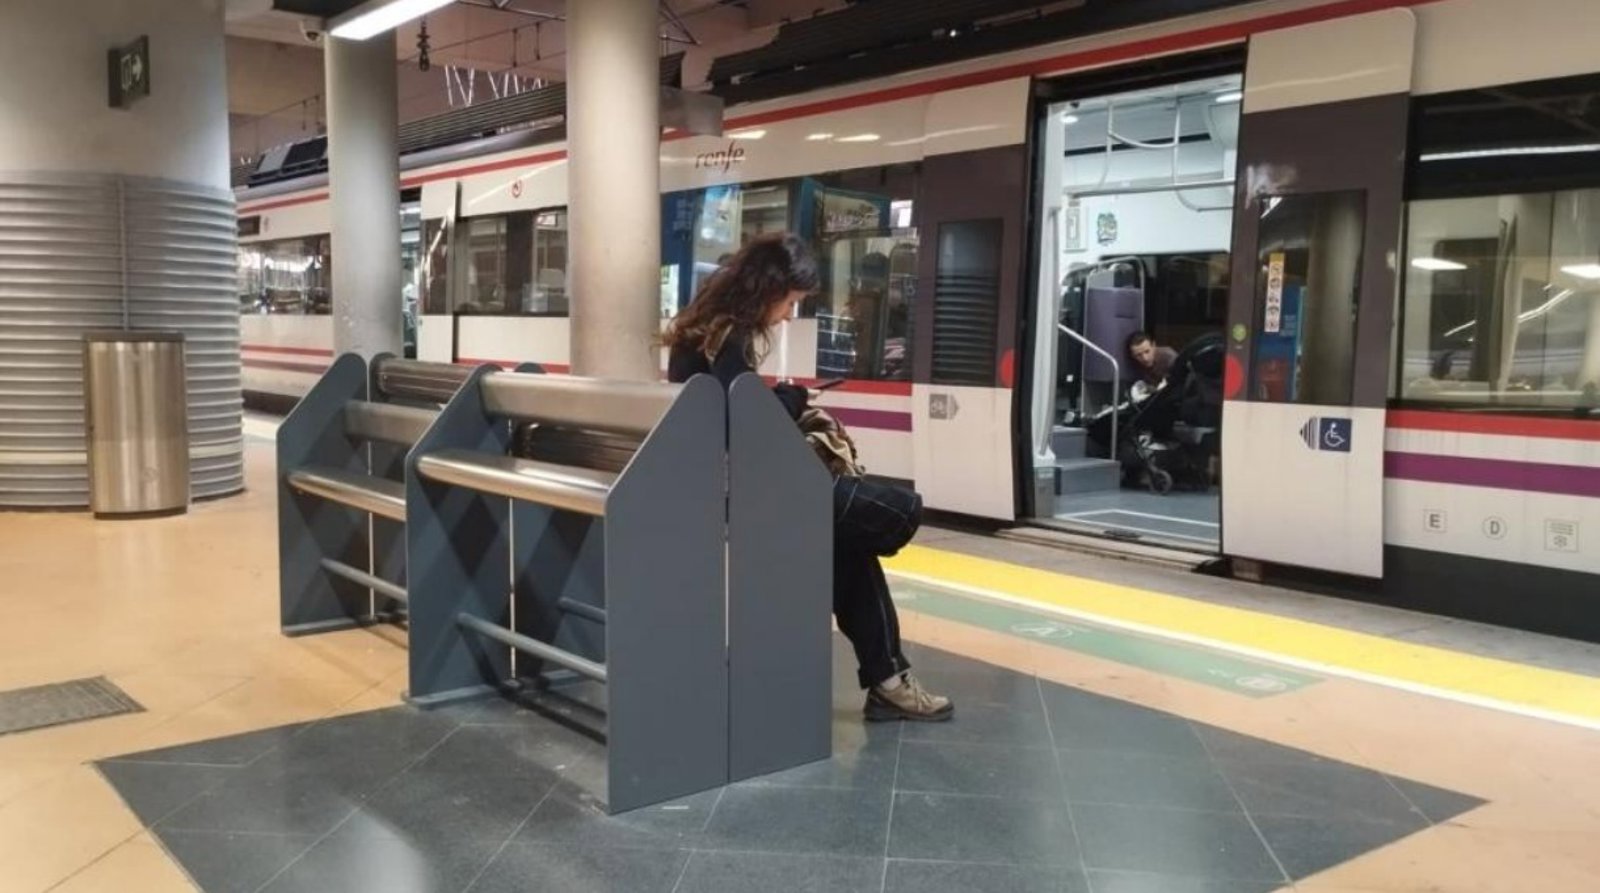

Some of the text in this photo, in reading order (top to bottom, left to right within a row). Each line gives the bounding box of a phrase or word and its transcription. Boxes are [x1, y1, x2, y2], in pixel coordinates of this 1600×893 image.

[695, 140, 745, 173] renfe
[1429, 513, 1441, 529] E
[1490, 520, 1501, 535] D
